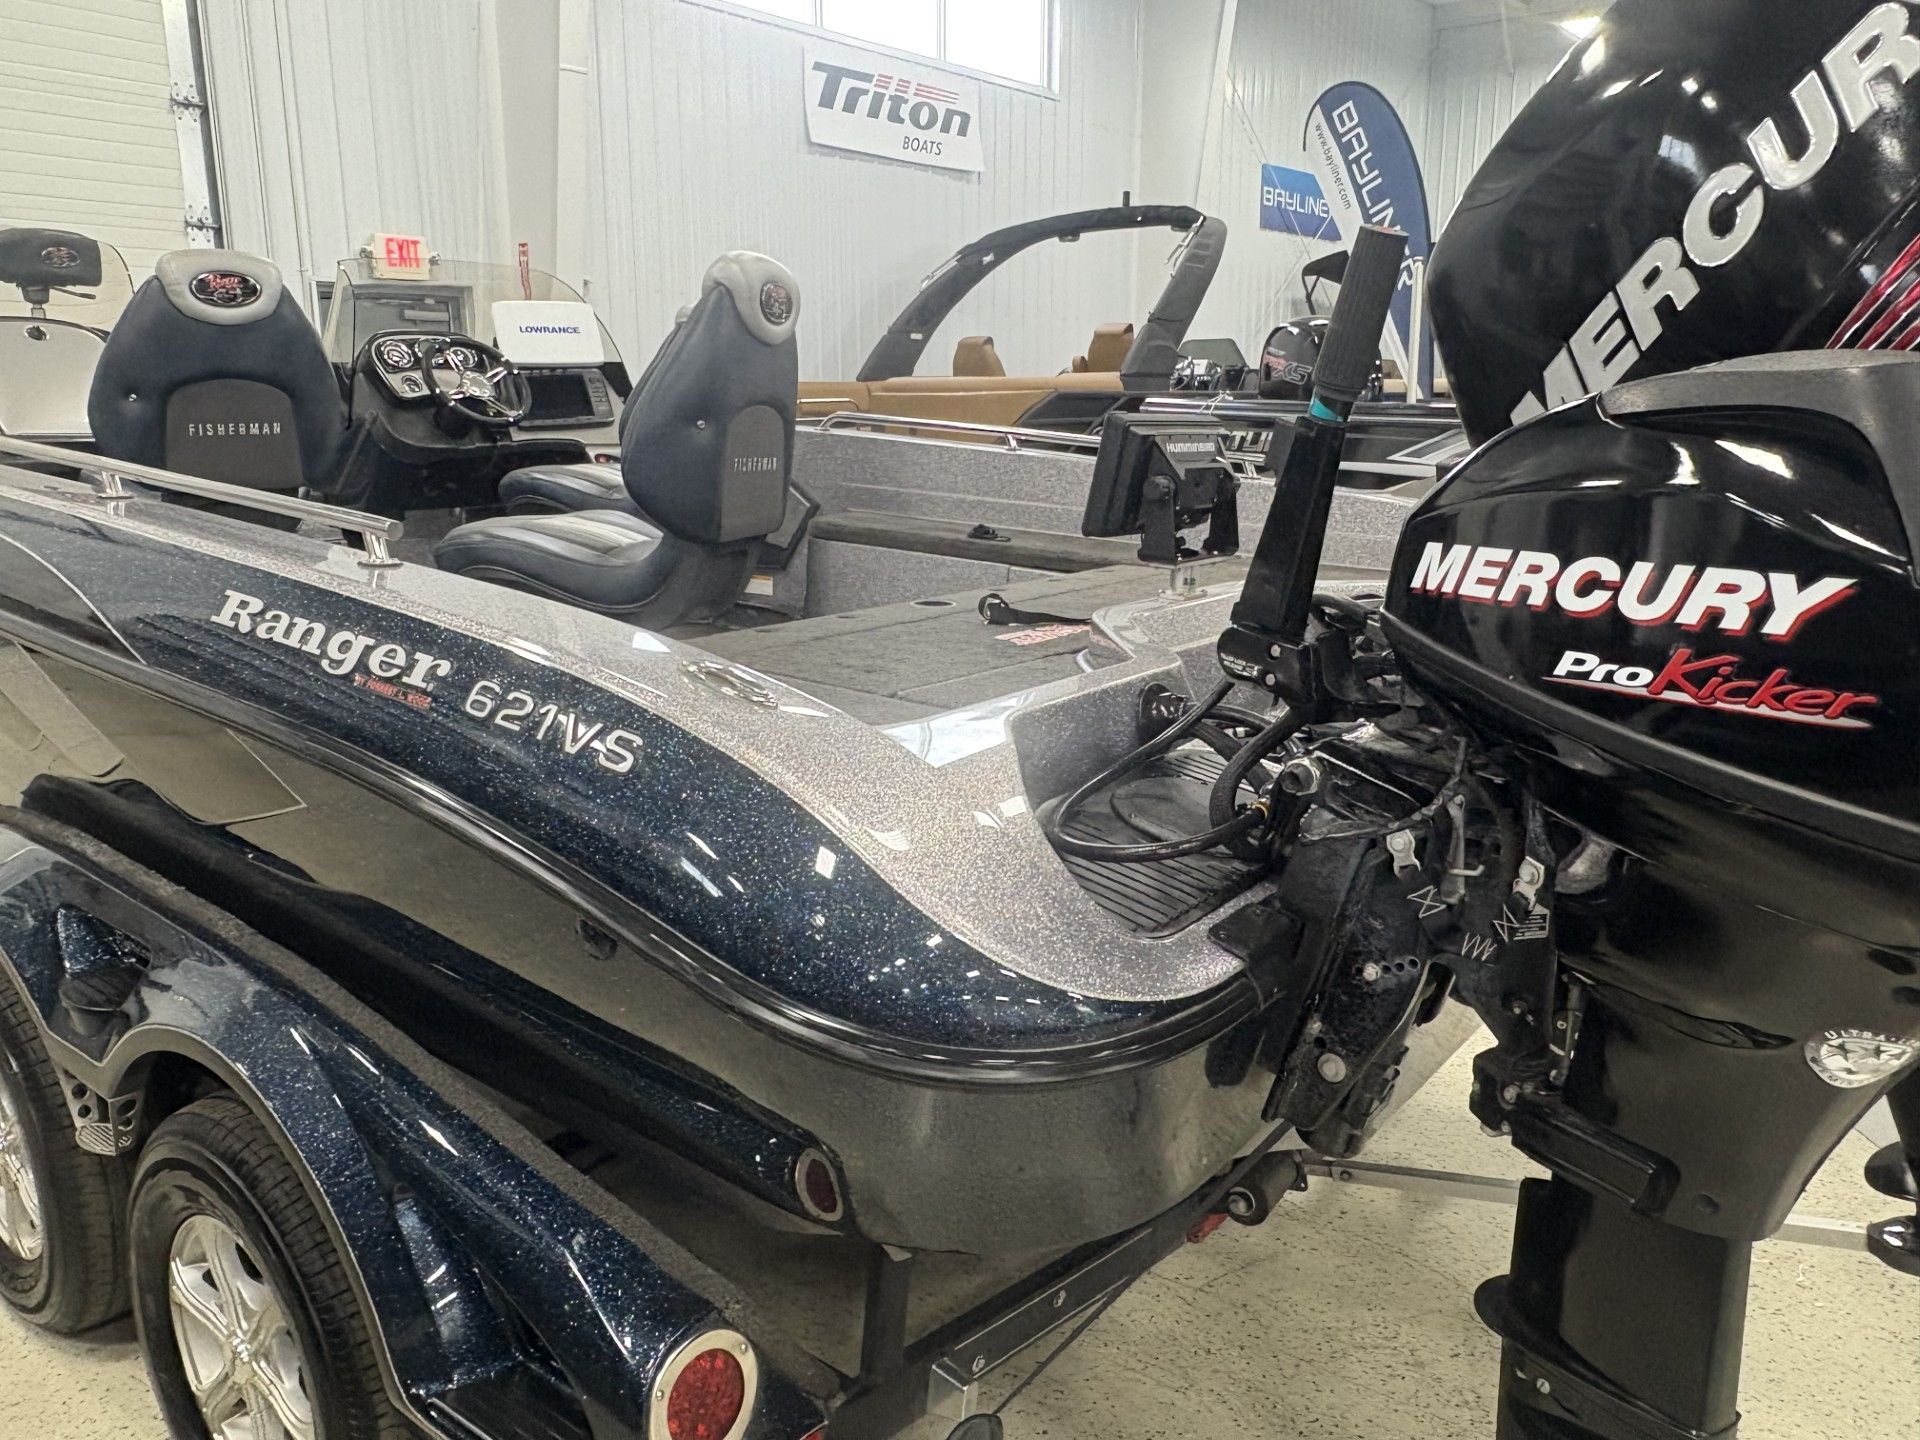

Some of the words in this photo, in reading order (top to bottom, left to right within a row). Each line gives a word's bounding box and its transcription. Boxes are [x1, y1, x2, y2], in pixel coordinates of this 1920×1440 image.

[812, 61, 971, 138] Triton
[902, 136, 943, 157] BOATS
[1314, 122, 1352, 211] www.bayliner.com
[1262, 186, 1330, 218] BAYLINE
[1331, 99, 1415, 291] BAYLINR
[385, 237, 422, 269] EXIT
[518, 325, 582, 335] LOWRANCE
[188, 422, 281, 437] FISHERMAN
[1409, 541, 1860, 642] MERCURY
[210, 588, 453, 692] Ranger
[464, 679, 644, 774] 621VS
